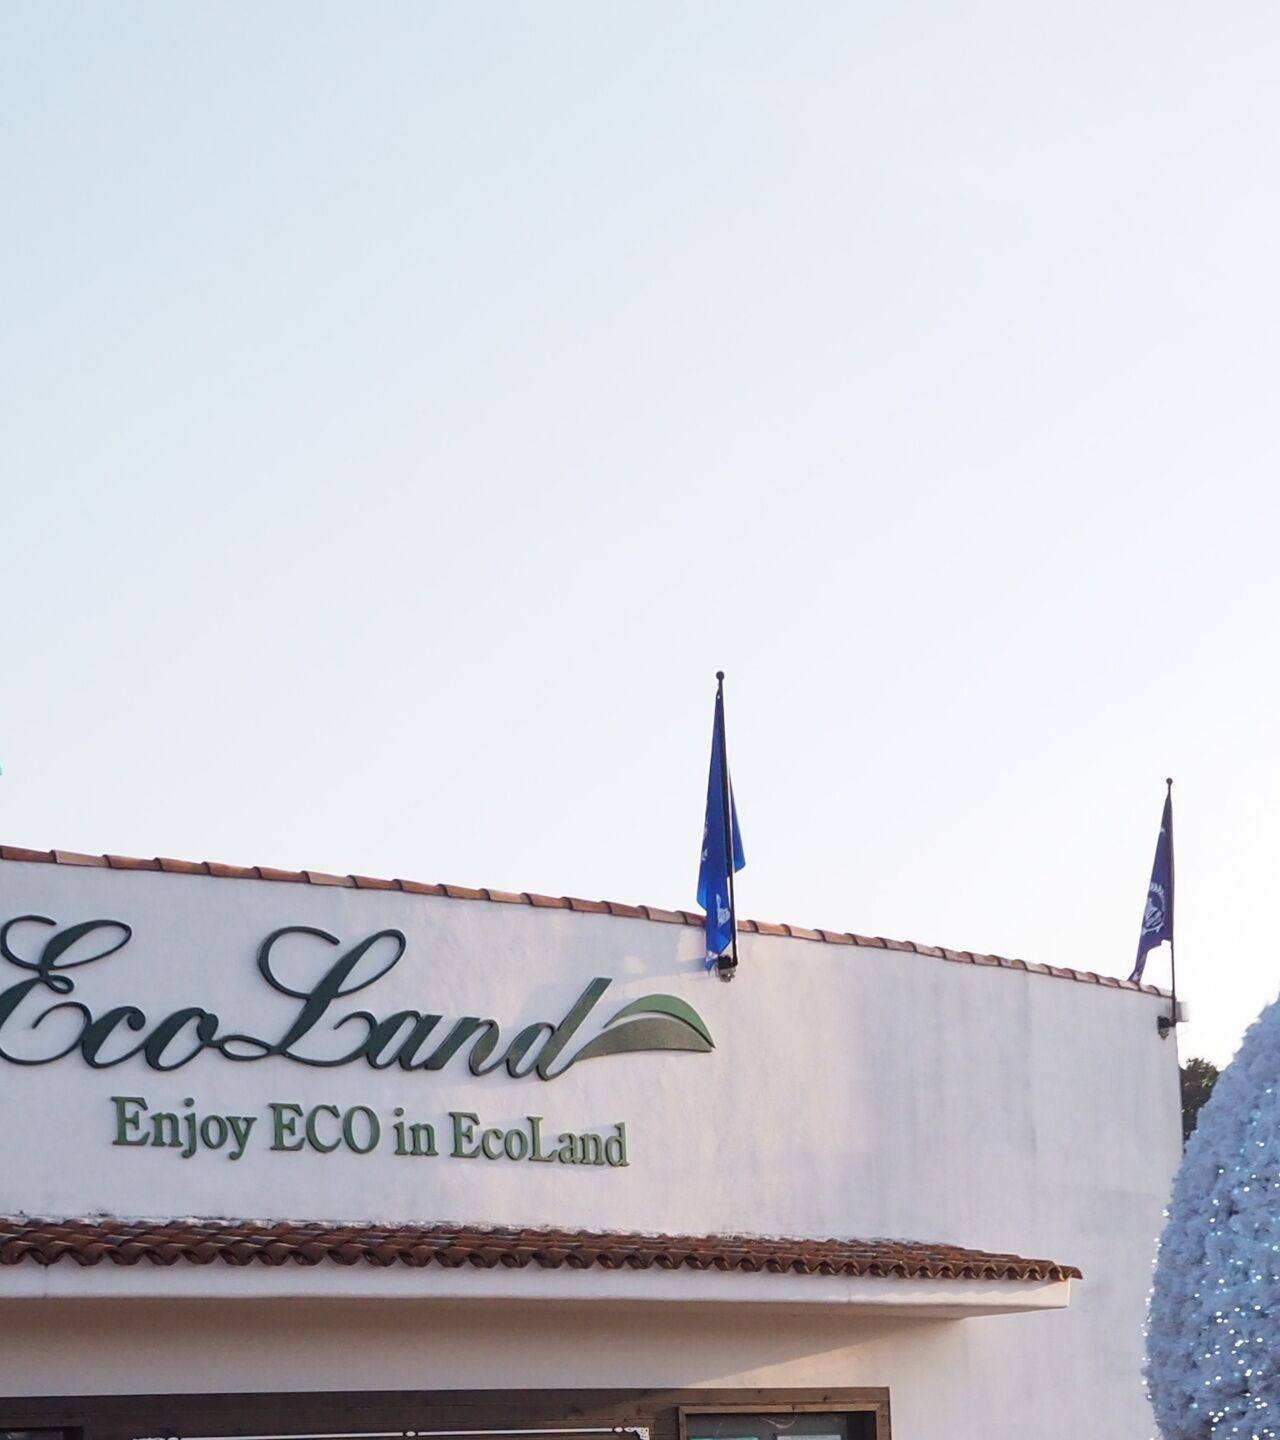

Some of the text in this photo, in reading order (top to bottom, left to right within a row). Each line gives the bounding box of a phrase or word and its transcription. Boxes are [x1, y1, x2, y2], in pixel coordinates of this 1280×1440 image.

[111, 1095, 631, 1168] Enjoy ECO in EcoLand
